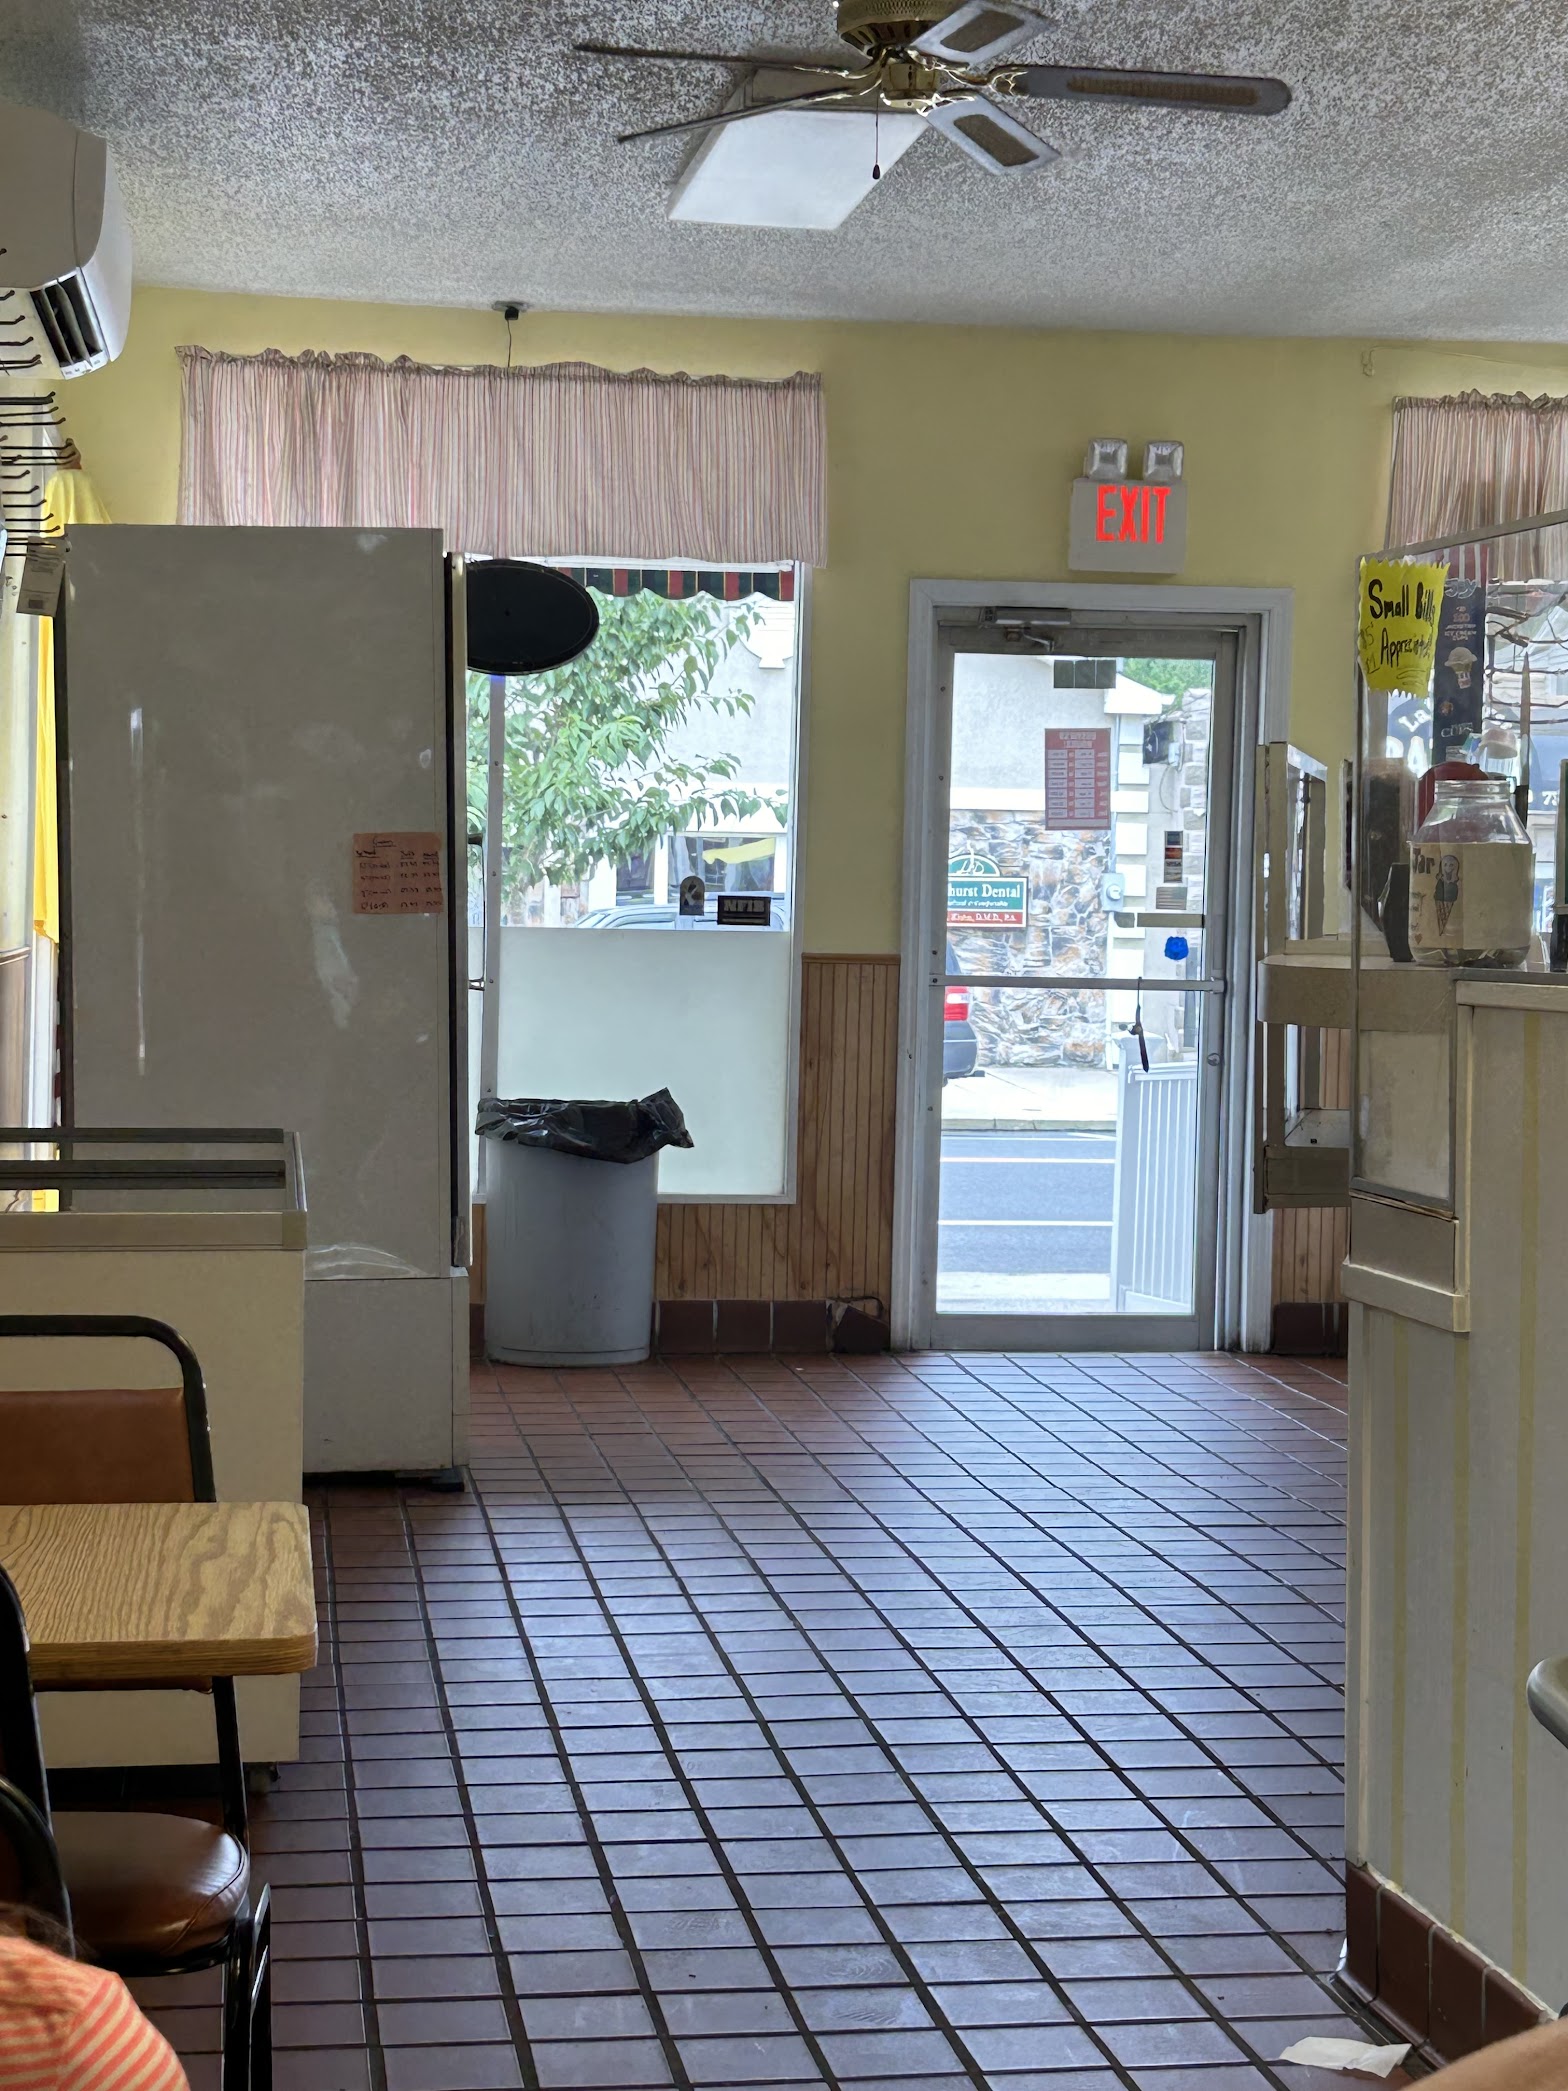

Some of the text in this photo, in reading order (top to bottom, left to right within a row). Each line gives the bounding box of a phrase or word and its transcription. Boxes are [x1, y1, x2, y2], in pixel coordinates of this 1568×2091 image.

[1096, 484, 1171, 544] EXIT
[1368, 578, 1410, 619] Small
[981, 884, 1021, 898] Dental
